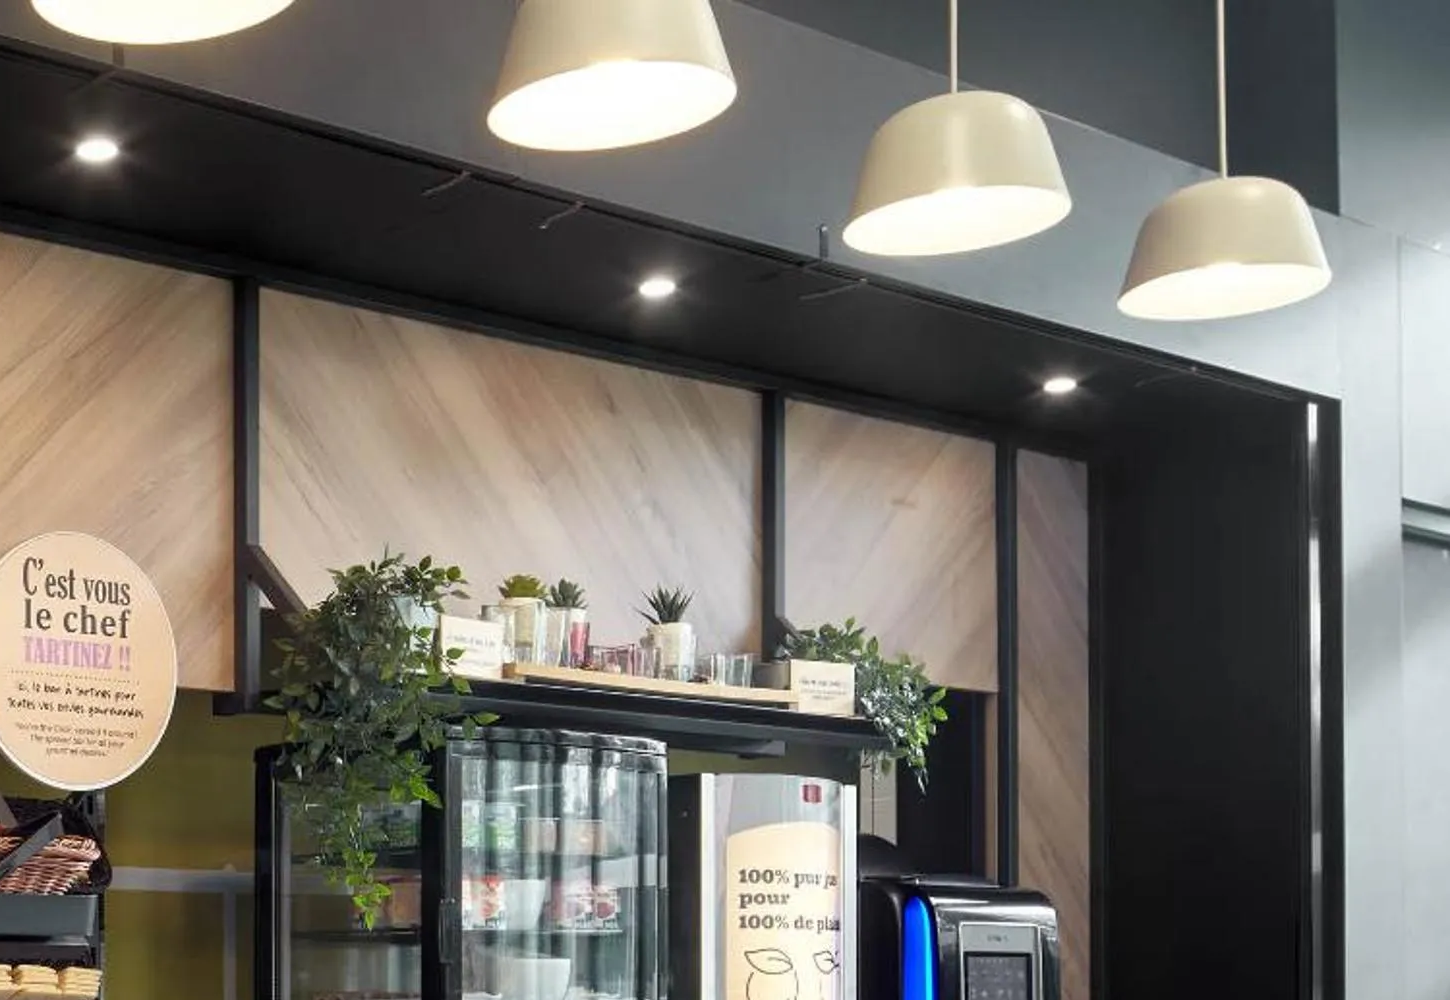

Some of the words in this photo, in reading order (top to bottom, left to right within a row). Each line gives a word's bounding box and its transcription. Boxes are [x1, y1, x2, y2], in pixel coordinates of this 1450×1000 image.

[23, 556, 75, 600] C'est
[83, 577, 130, 606] vous
[25, 598, 51, 630] le
[63, 604, 131, 638] chef
[24, 636, 112, 669] TARTINEZ
[739, 869, 790, 885] 100%
[739, 892, 790, 910] pour
[739, 915, 790, 930] 100%
[794, 915, 814, 930] de
